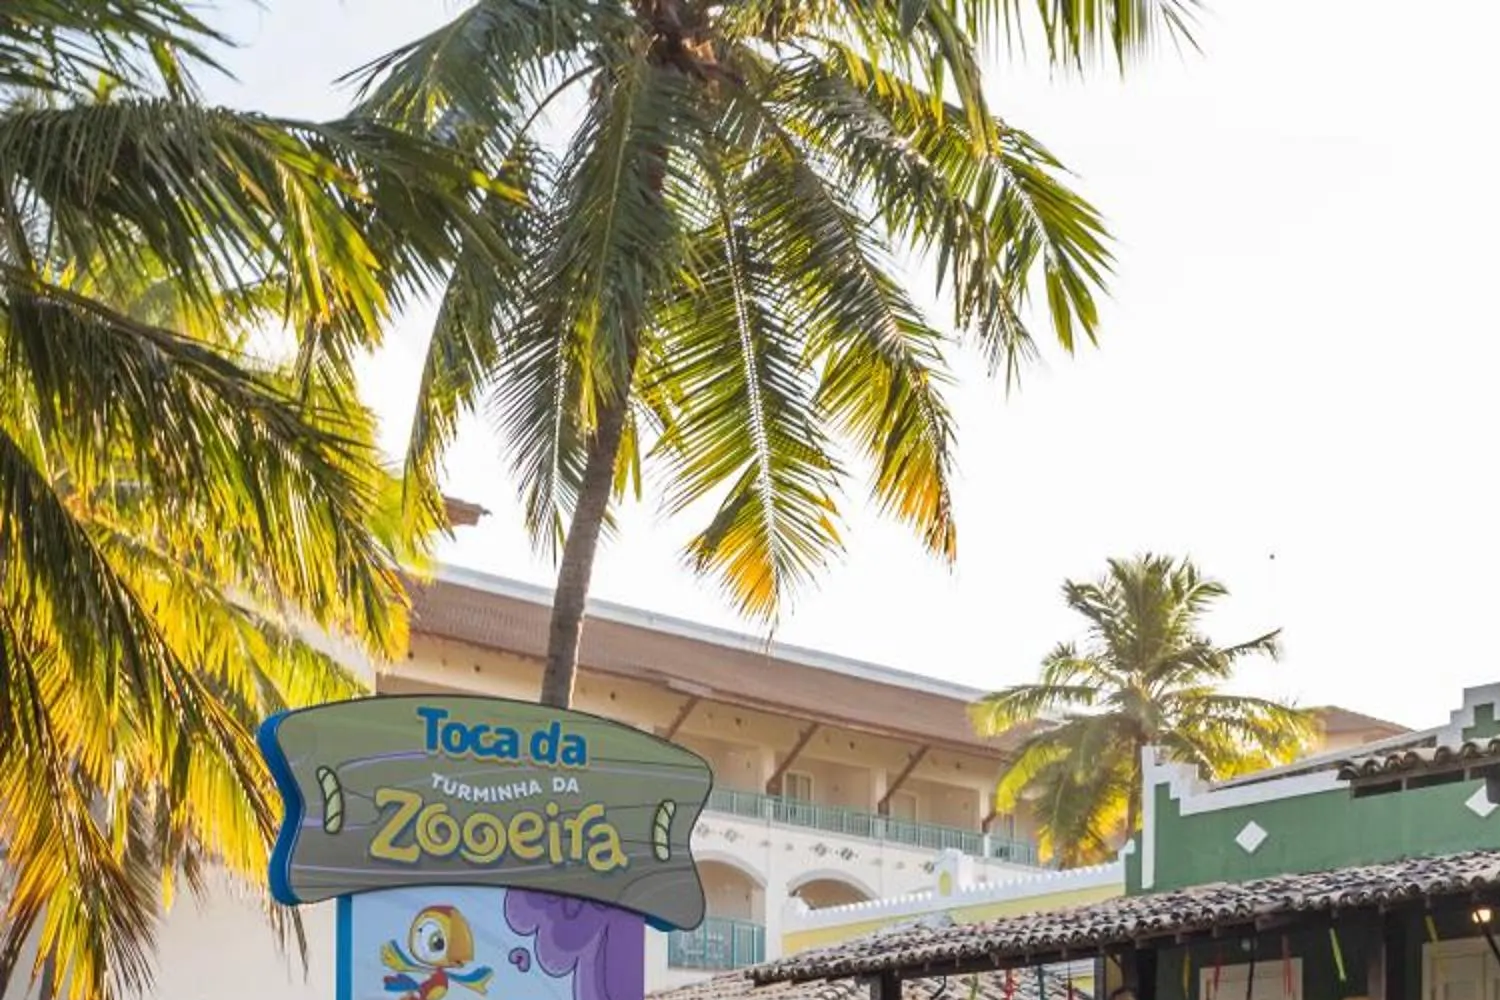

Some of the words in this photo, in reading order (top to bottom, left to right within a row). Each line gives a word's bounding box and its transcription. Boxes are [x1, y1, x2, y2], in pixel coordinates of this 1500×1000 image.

[417, 707, 520, 759] Toca
[530, 721, 588, 766] da
[431, 773, 543, 802] TURMINHA
[552, 777, 580, 794] DA
[369, 787, 629, 872] Zooeira
